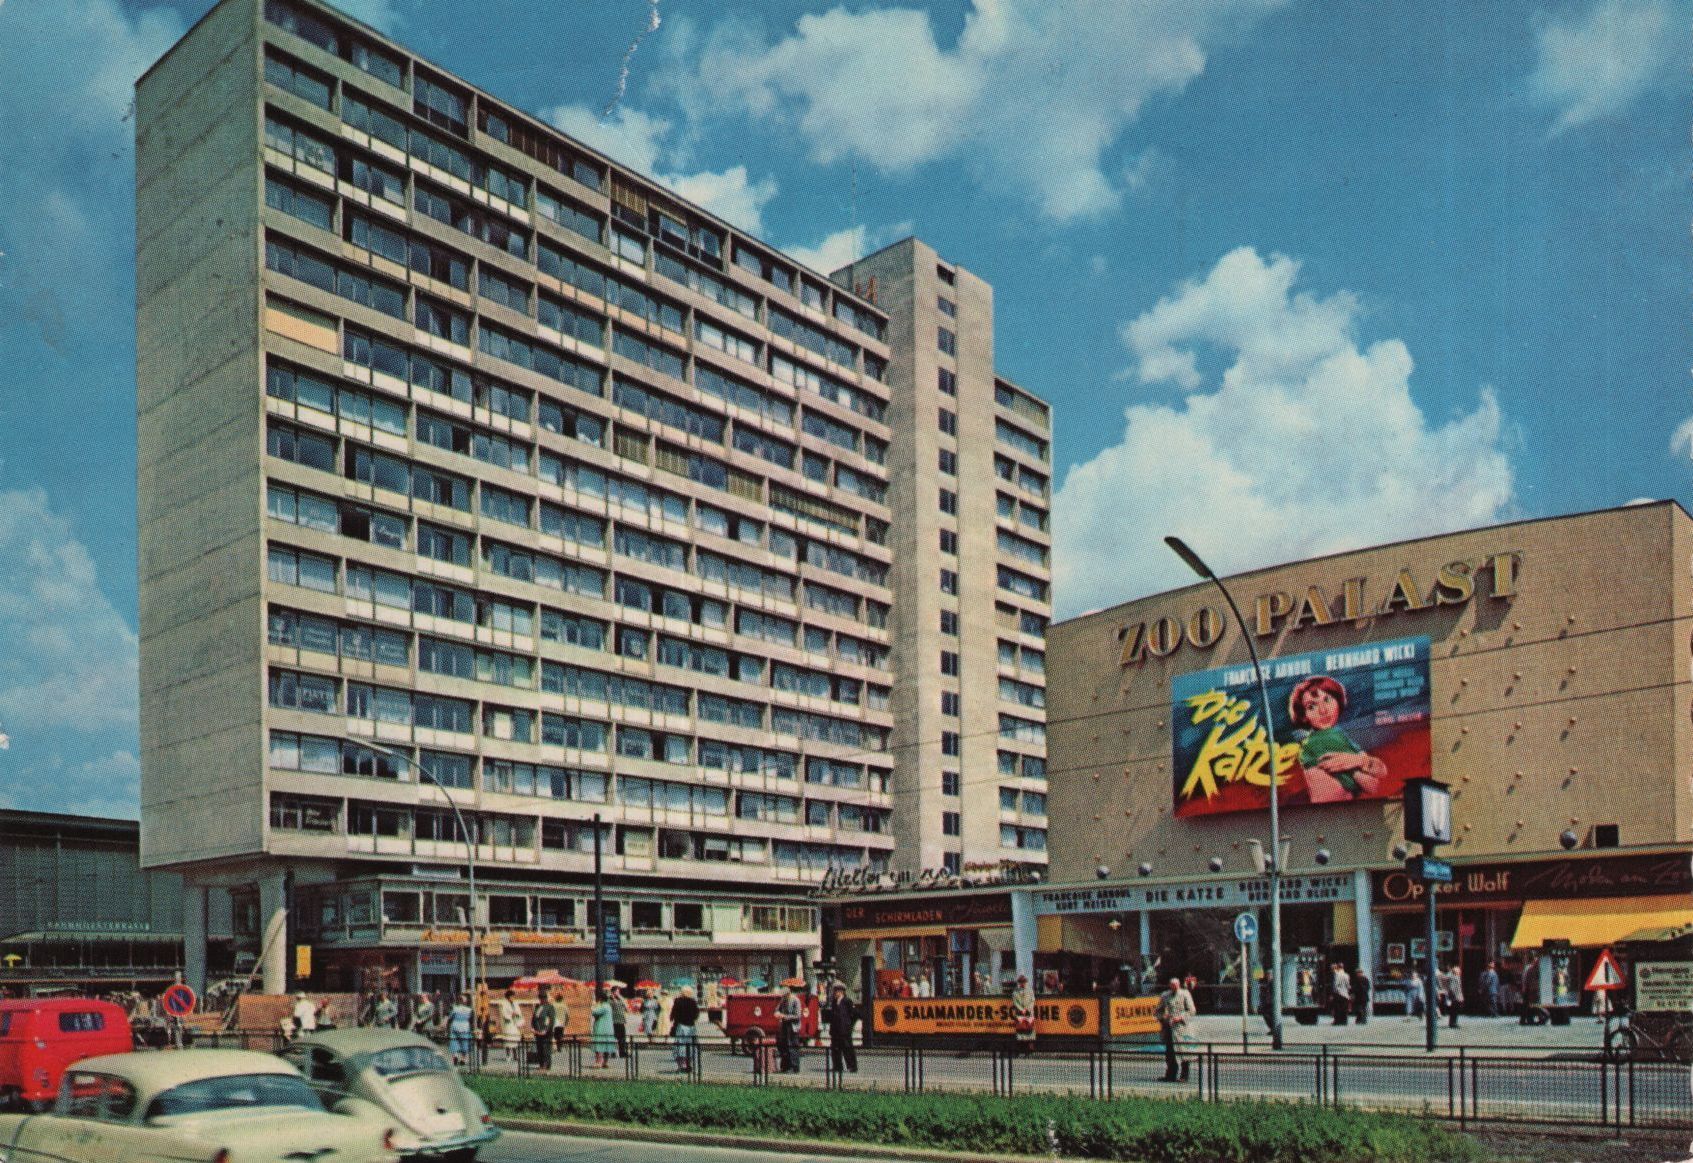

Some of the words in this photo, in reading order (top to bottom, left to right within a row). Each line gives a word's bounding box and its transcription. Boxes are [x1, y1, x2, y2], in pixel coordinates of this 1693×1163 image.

[1116, 604, 1226, 668] ZOO
[1254, 549, 1523, 638] PALAST
[1183, 688, 1251, 725] Die
[1179, 713, 1301, 804] Katze
[1145, 891, 1168, 904] DIE
[1175, 886, 1224, 902] KATZE
[1239, 880, 1302, 892] BERNARD
[1383, 872, 1462, 900] Opker
[1247, 889, 1300, 902] BERARD
[903, 1004, 1060, 1022] SALAMANDER-SCHE
[1115, 1005, 1157, 1020] SALAMAN
